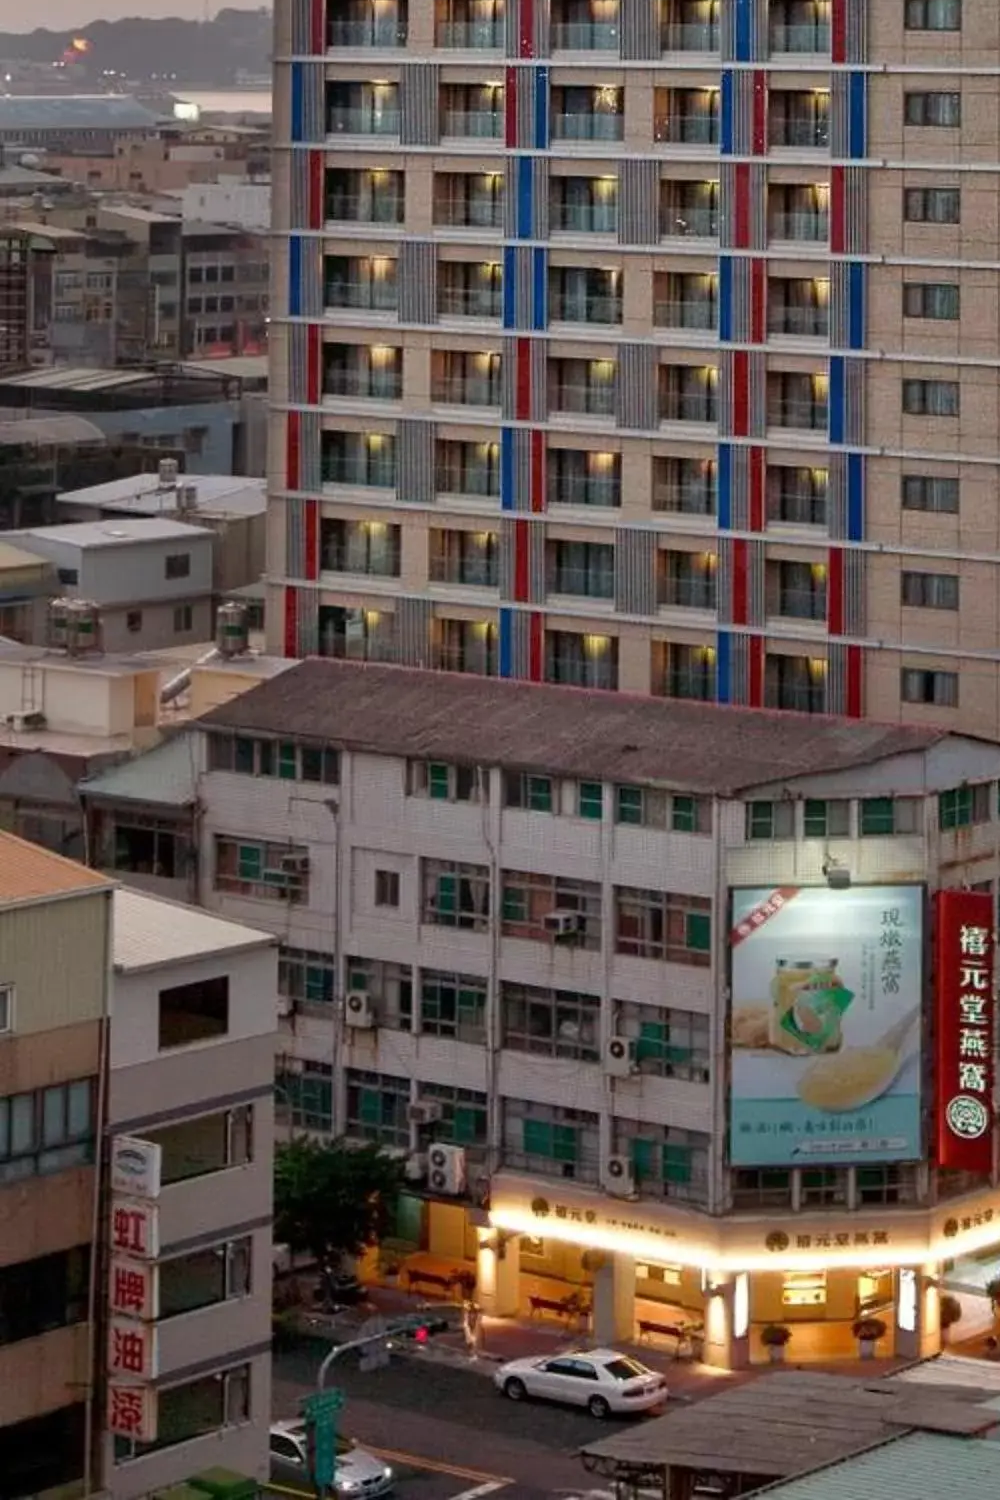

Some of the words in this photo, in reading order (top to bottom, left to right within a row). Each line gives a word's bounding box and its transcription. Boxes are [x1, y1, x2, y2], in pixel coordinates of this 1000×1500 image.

[958, 925, 991, 1093] 禧元堂燕窩
[110, 1208, 147, 1436] 虹牌油漆
